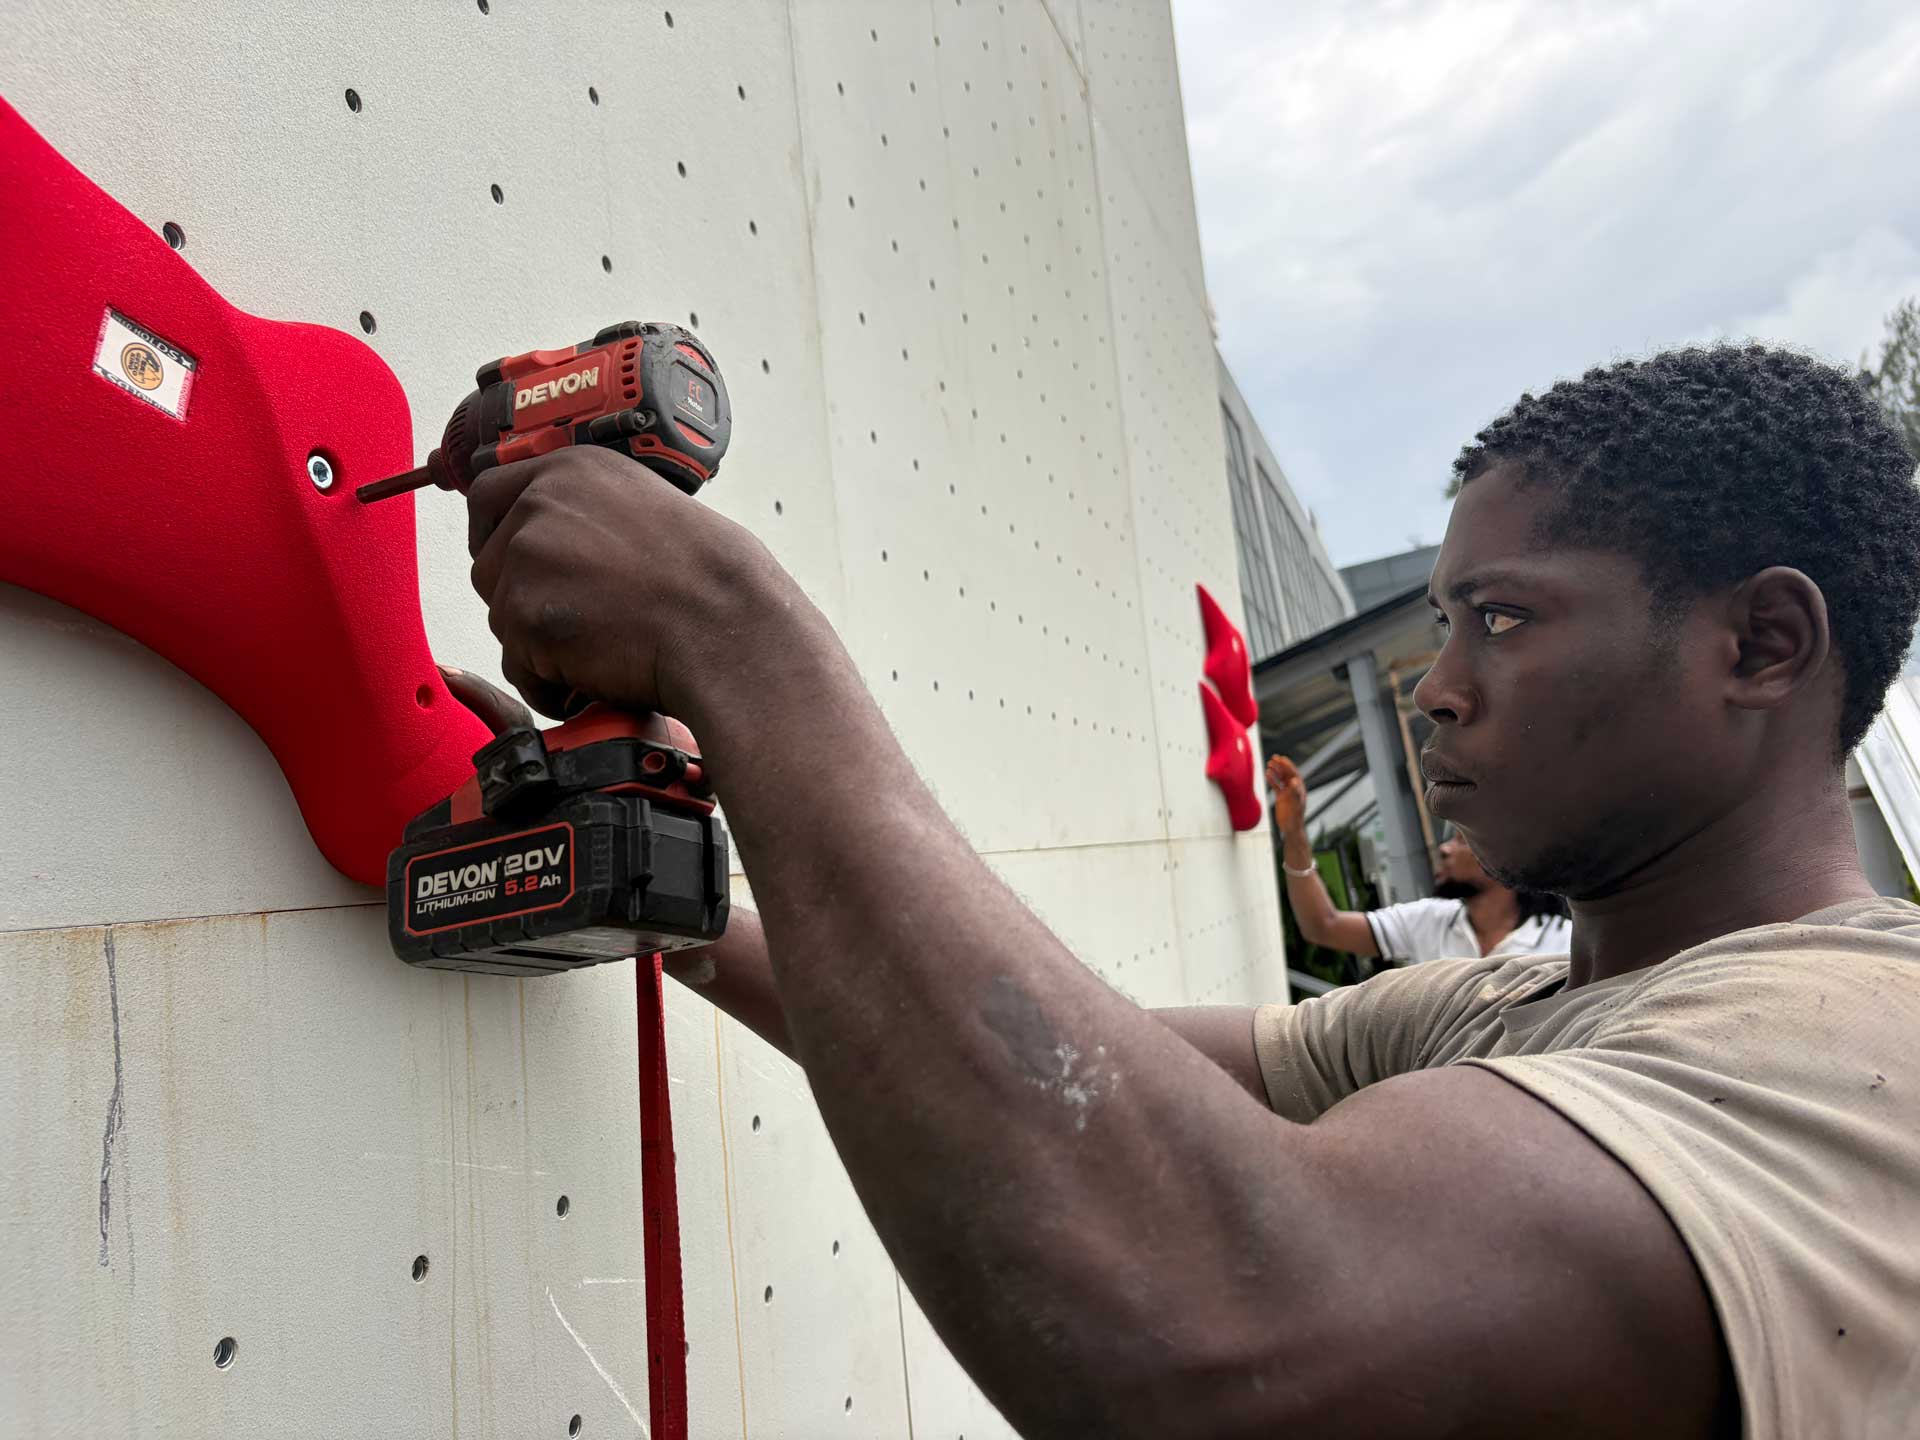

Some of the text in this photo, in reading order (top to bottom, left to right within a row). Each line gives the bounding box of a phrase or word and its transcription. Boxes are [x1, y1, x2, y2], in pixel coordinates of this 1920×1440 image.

[134, 327, 180, 361] HOLDS
[515, 366, 600, 410] DEVON
[688, 380, 704, 402] EC
[417, 844, 566, 899] DEVON 20V
[416, 888, 497, 914] LITHIUM-ION
